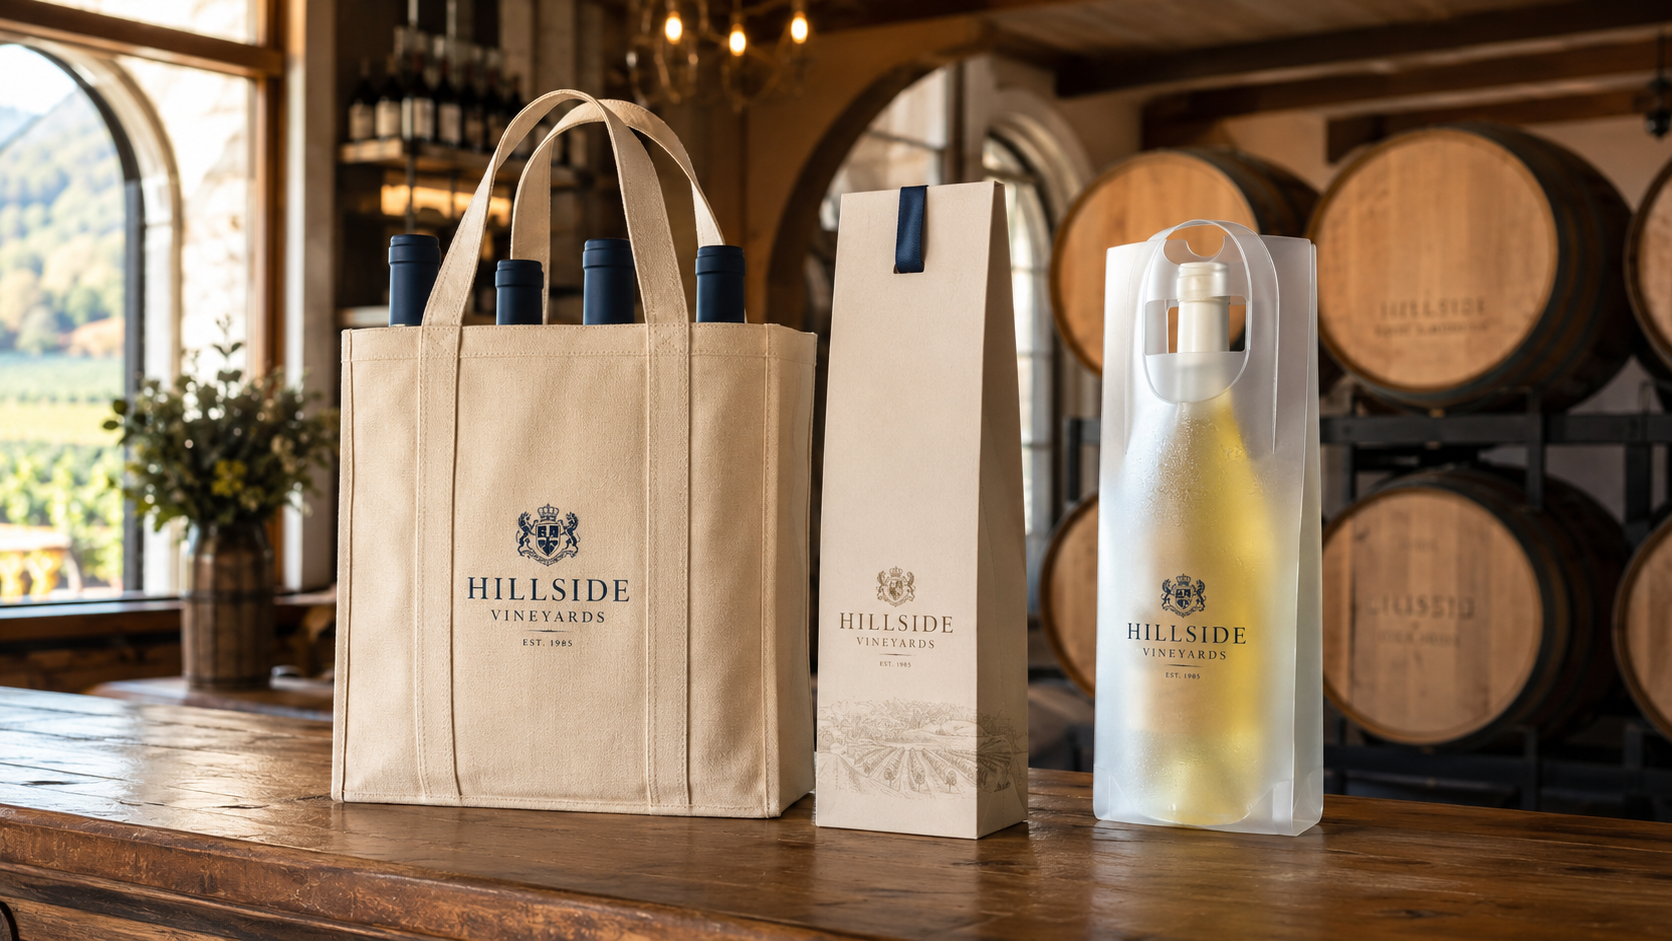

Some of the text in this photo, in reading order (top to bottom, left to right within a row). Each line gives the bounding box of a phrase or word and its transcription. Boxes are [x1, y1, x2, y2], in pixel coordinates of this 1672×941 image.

[467, 576, 630, 602] HILLSIDE
[491, 609, 605, 623] VINEYARDS
[839, 612, 954, 634] HILLSIDE
[1127, 622, 1247, 645] HILLSIDE
[522, 638, 546, 647] EST.
[856, 636, 935, 649] VINEYARDS
[1142, 647, 1227, 660] VINEYARDS
[1165, 671, 1181, 679] EST.
